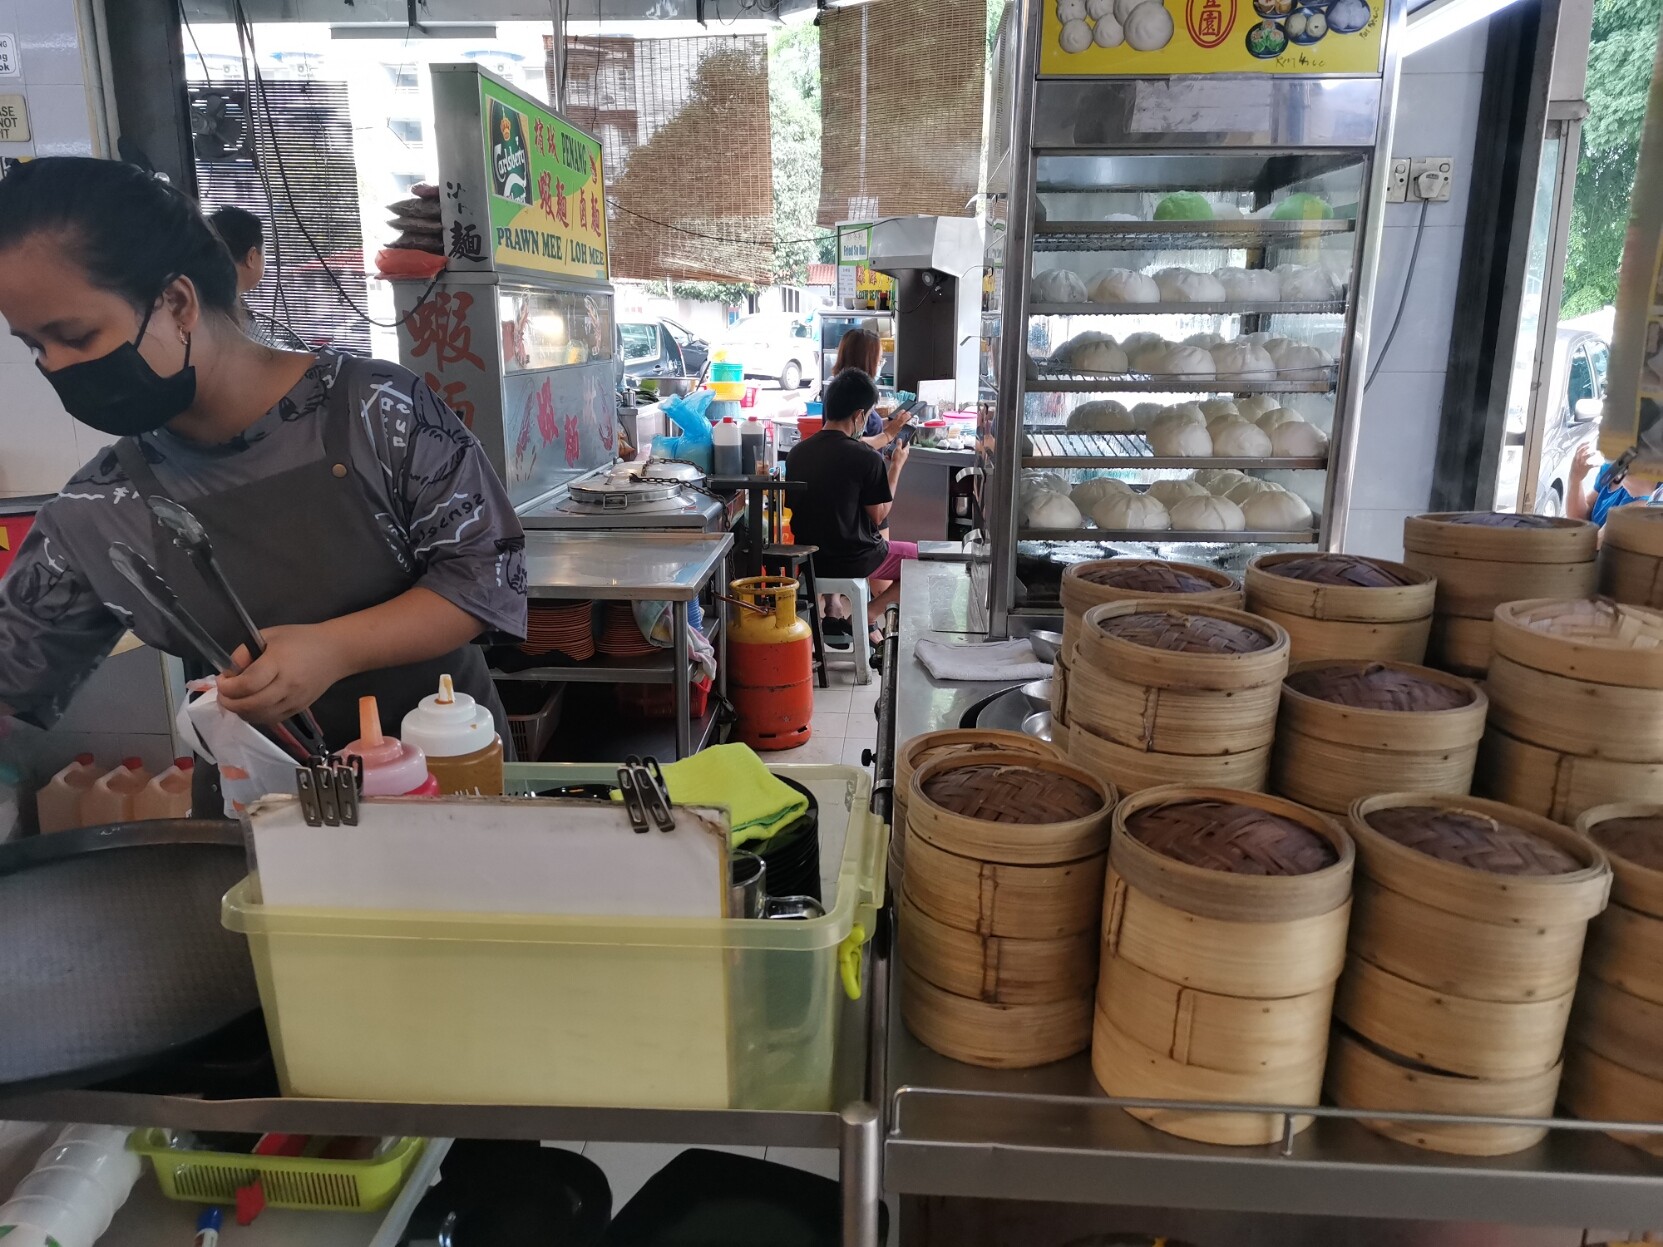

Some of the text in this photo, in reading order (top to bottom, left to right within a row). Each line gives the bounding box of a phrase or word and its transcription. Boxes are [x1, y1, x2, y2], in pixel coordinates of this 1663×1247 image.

[0, 106, 15, 117] SE
[494, 143, 526, 182] Carlsberg
[560, 132, 587, 175] PENANG
[446, 181, 489, 262] 麵
[496, 227, 540, 256] PRAWN
[541, 231, 563, 260] MEE
[570, 239, 587, 264] LOH
[588, 245, 605, 266] MEE
